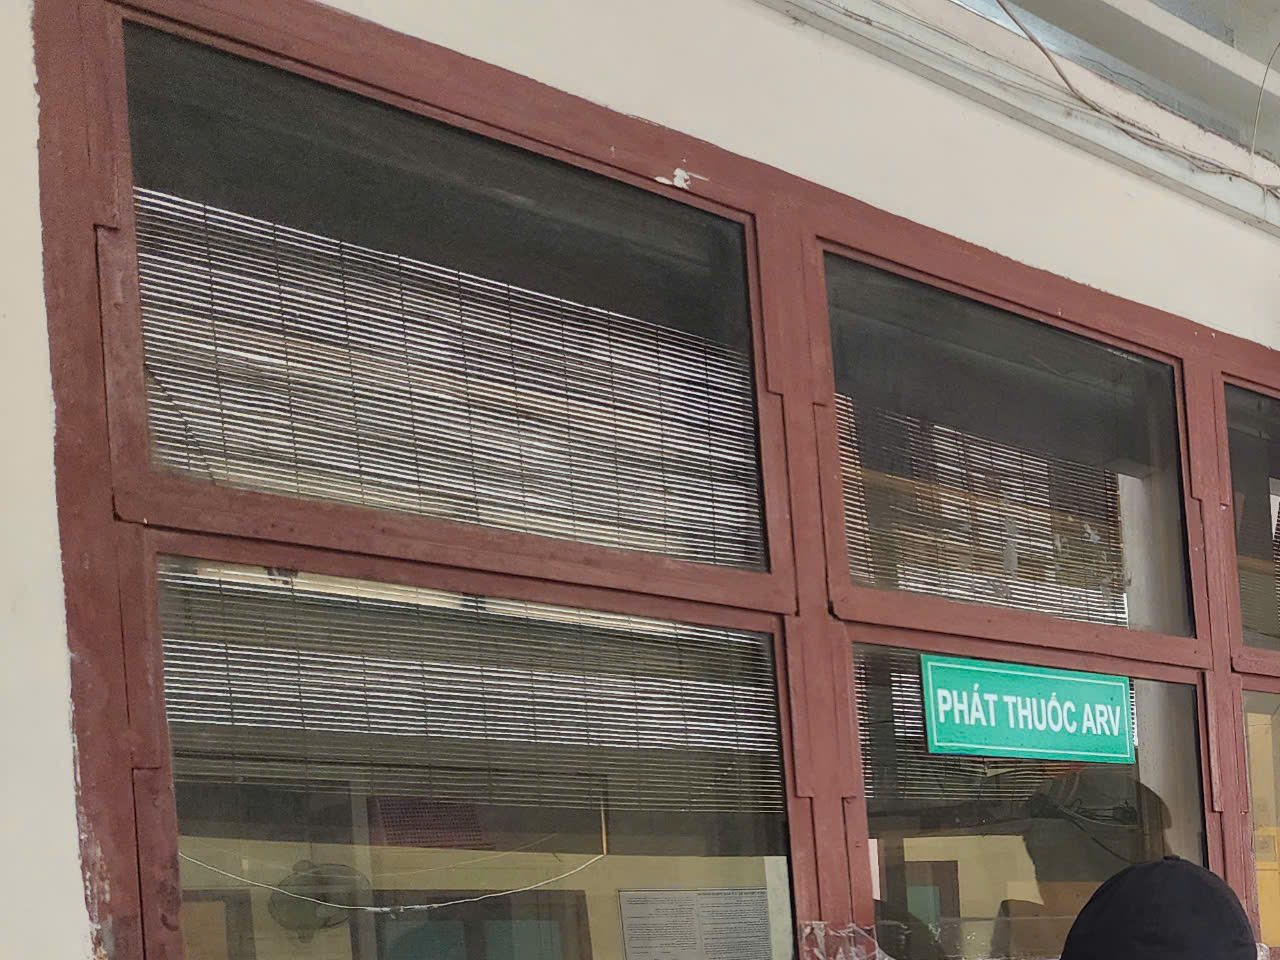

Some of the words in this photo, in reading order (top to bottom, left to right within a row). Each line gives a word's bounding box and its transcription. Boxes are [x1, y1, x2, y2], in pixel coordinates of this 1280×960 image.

[936, 682, 998, 727] PHÁT
[1003, 691, 1078, 734] THUỐC
[1082, 703, 1121, 737] ARV
